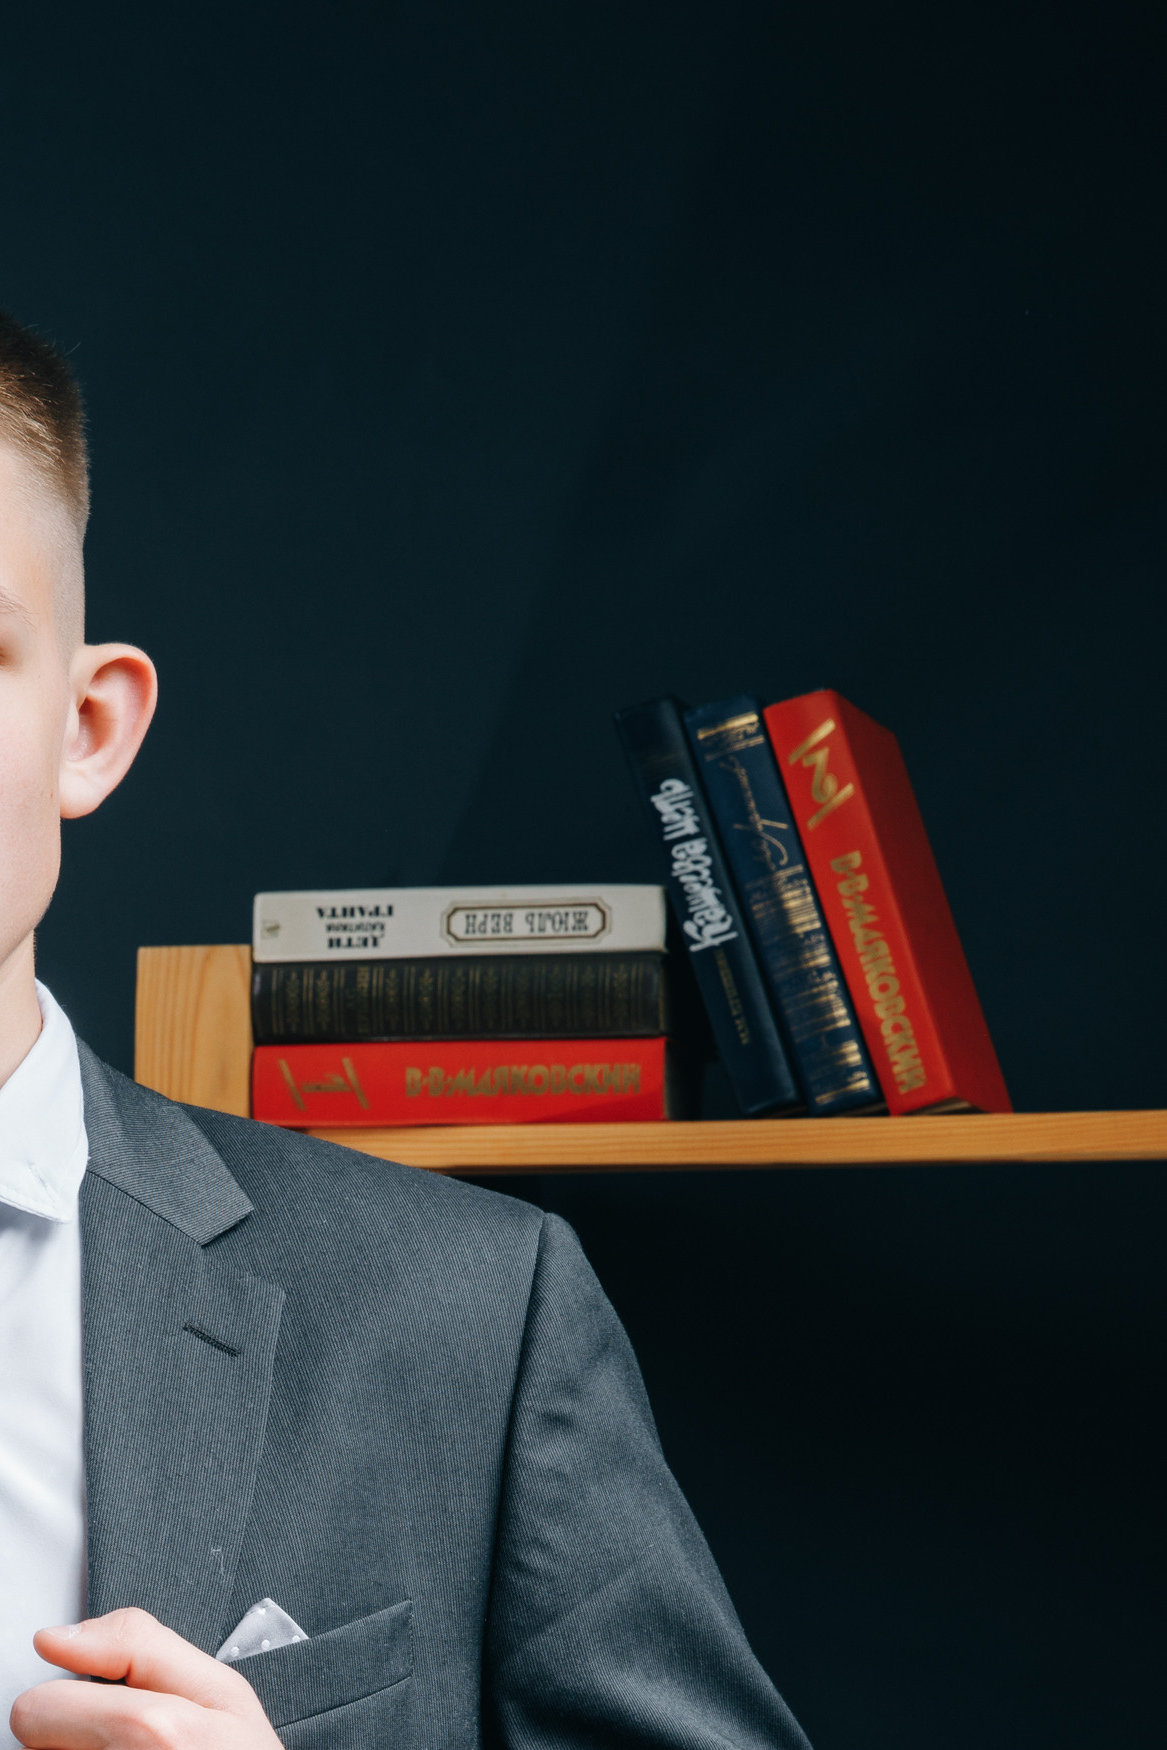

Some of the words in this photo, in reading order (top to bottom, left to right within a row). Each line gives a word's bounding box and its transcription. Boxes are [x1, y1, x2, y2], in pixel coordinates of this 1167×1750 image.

[316, 904, 394, 919] ГРАНТА
[464, 911, 515, 935] ВЕРН
[525, 911, 590, 934] ЖЮЛЬ
[328, 932, 385, 949] ДЕТИ
